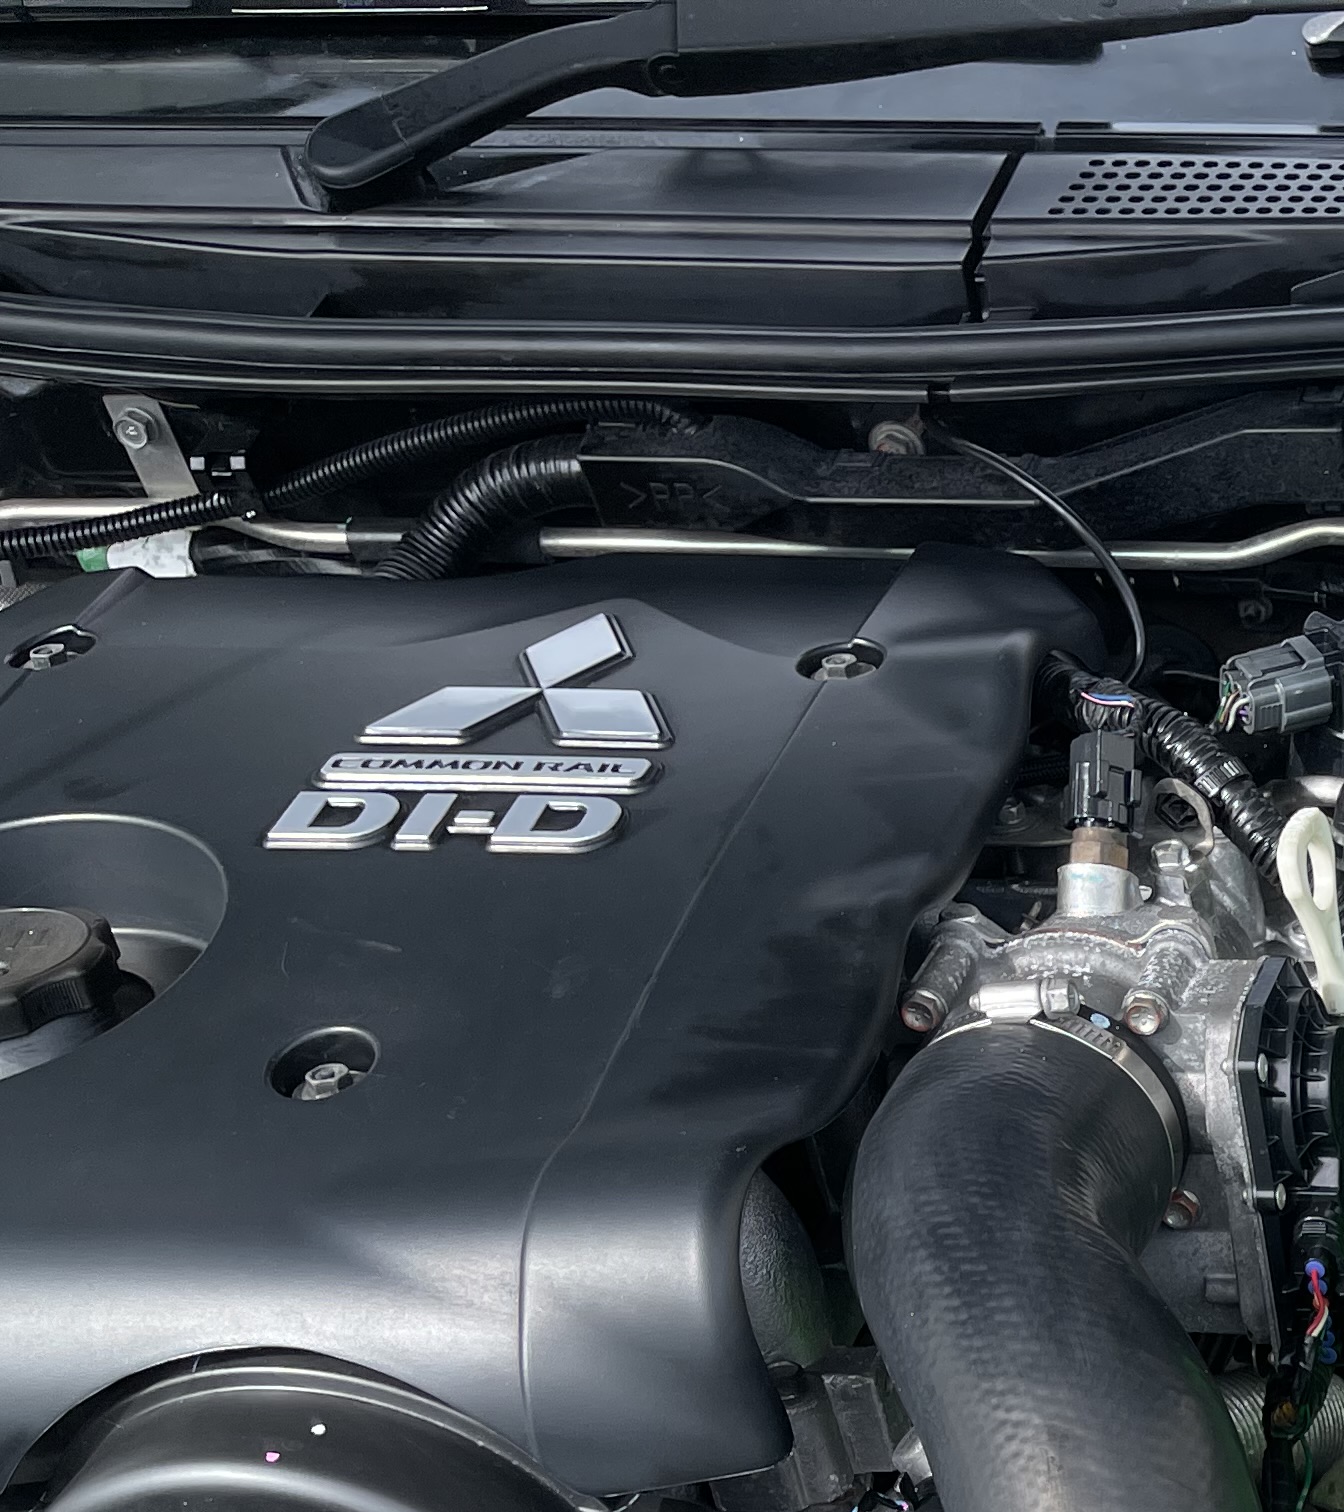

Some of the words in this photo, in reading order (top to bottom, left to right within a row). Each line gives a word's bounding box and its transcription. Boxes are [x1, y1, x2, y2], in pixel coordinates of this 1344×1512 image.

[331, 758, 523, 772] COMMON
[532, 760, 635, 775] RAIL
[262, 790, 623, 853] DI-D
